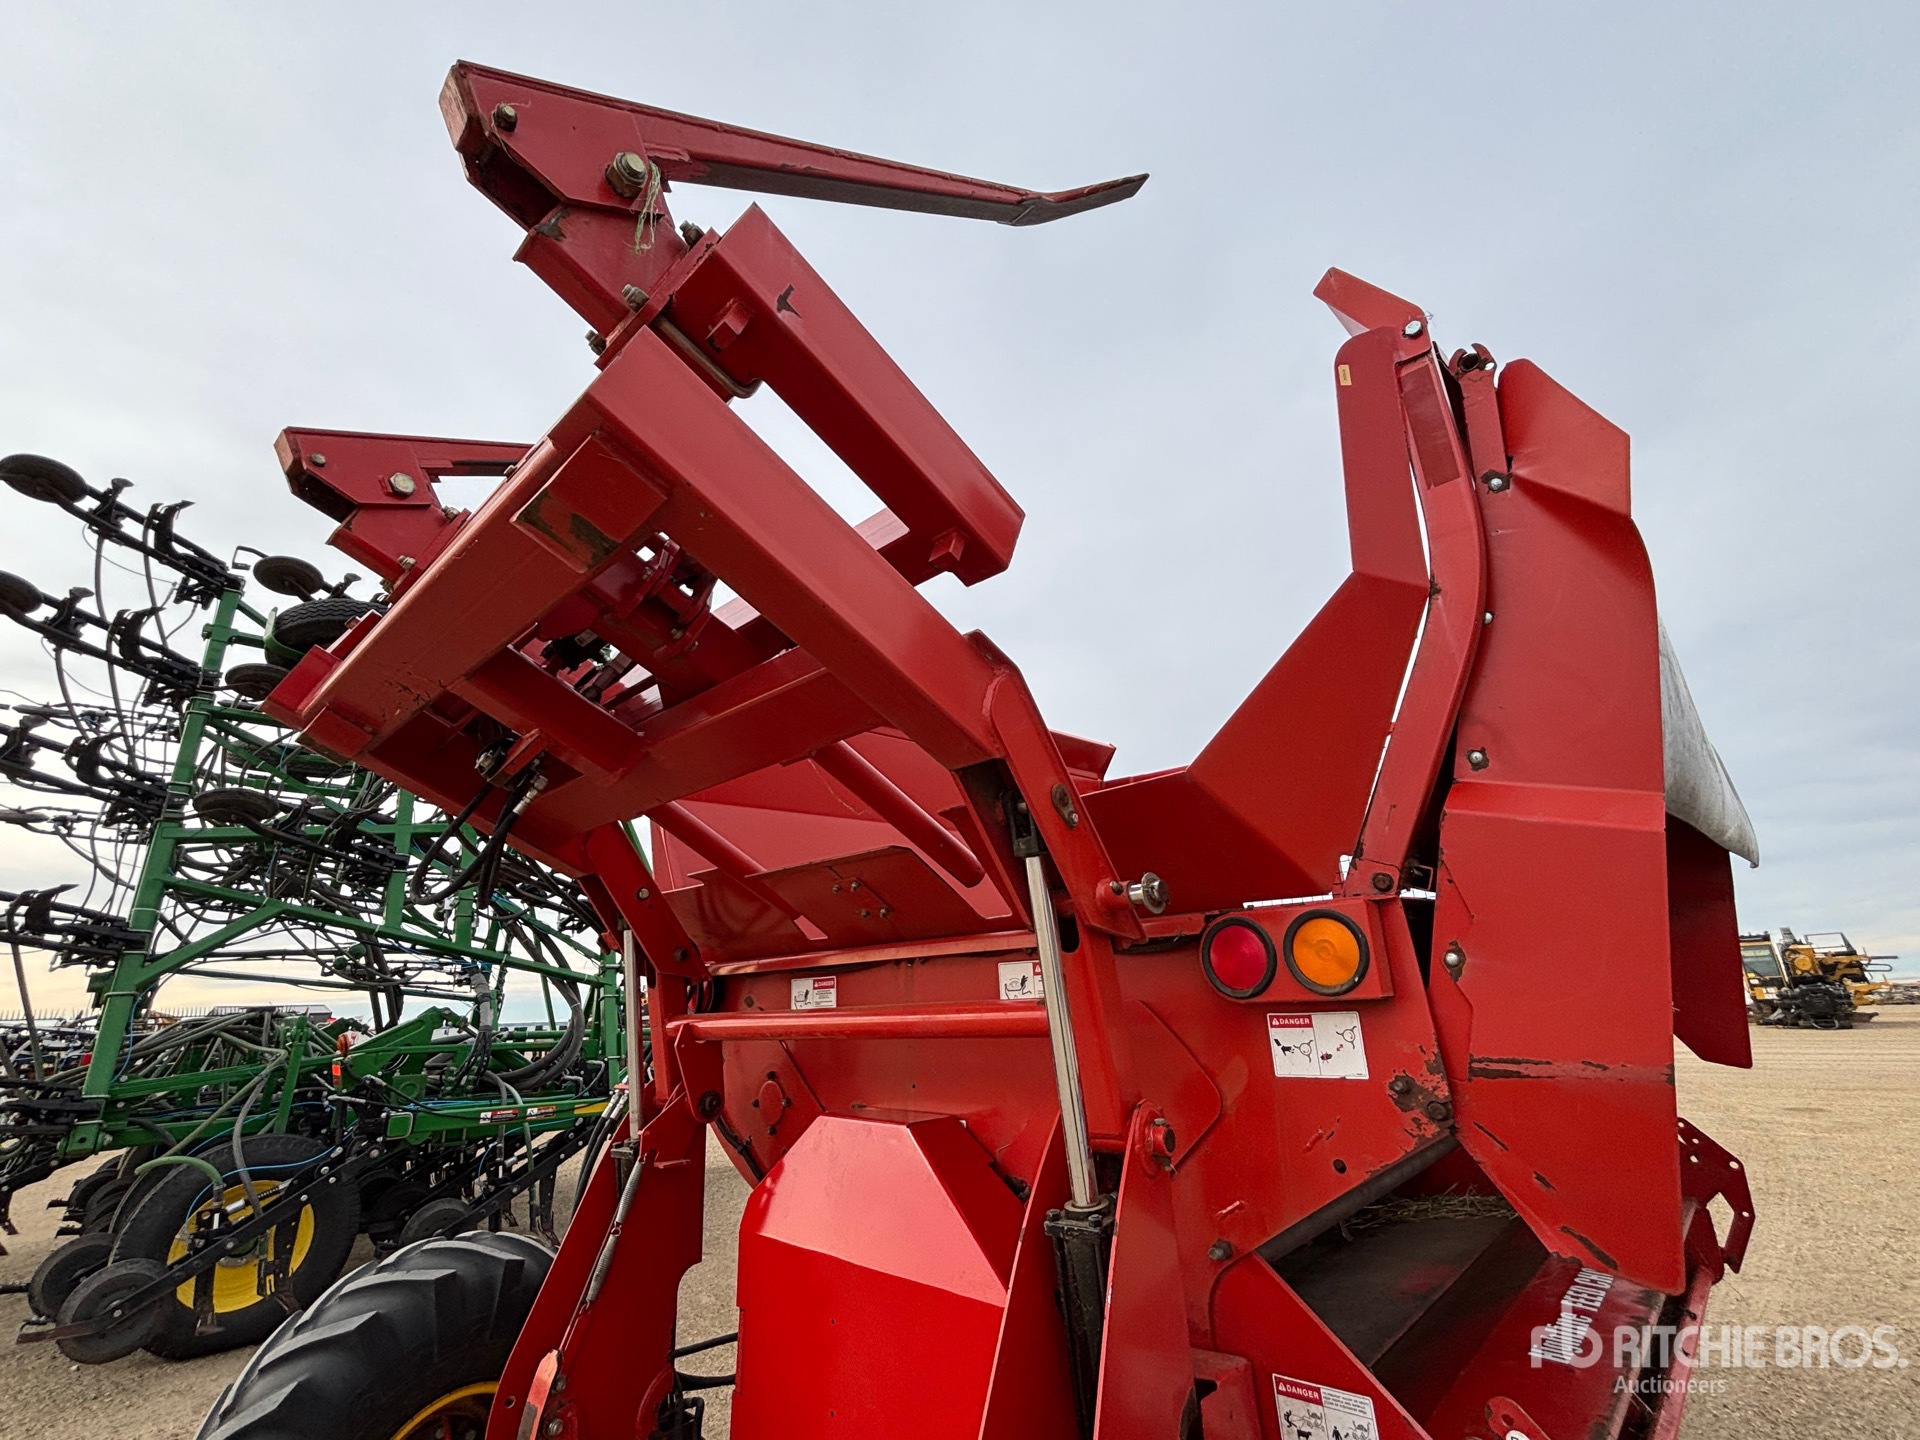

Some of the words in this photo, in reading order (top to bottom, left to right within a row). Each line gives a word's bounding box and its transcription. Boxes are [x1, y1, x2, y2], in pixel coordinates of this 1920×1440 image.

[1279, 1017, 1310, 1025] DANGER
[1528, 1312, 1593, 1364] Highline
[1561, 1285, 1606, 1312] FEED
[1286, 1384, 1320, 1400] DANGER
